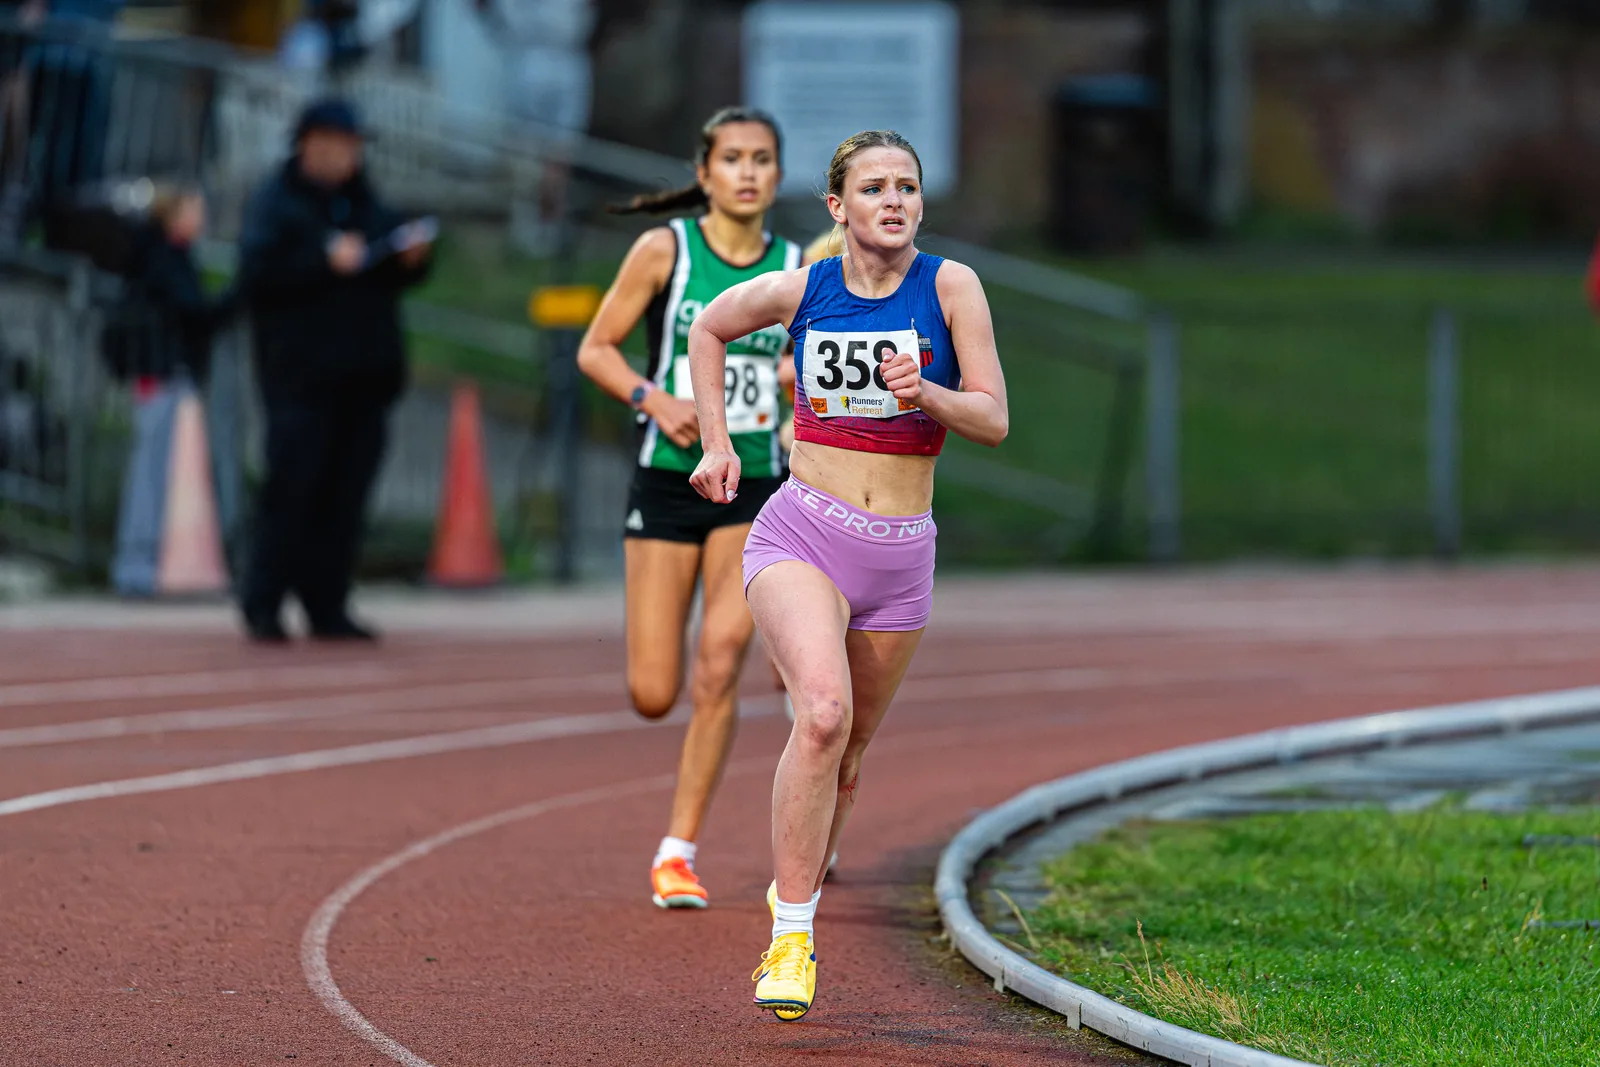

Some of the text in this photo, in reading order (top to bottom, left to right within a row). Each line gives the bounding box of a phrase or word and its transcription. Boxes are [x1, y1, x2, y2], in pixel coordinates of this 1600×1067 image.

[817, 340, 898, 391] 358
[851, 396, 885, 406] Runners'
[851, 405, 883, 415] Retreat
[824, 502, 890, 537] PRO
